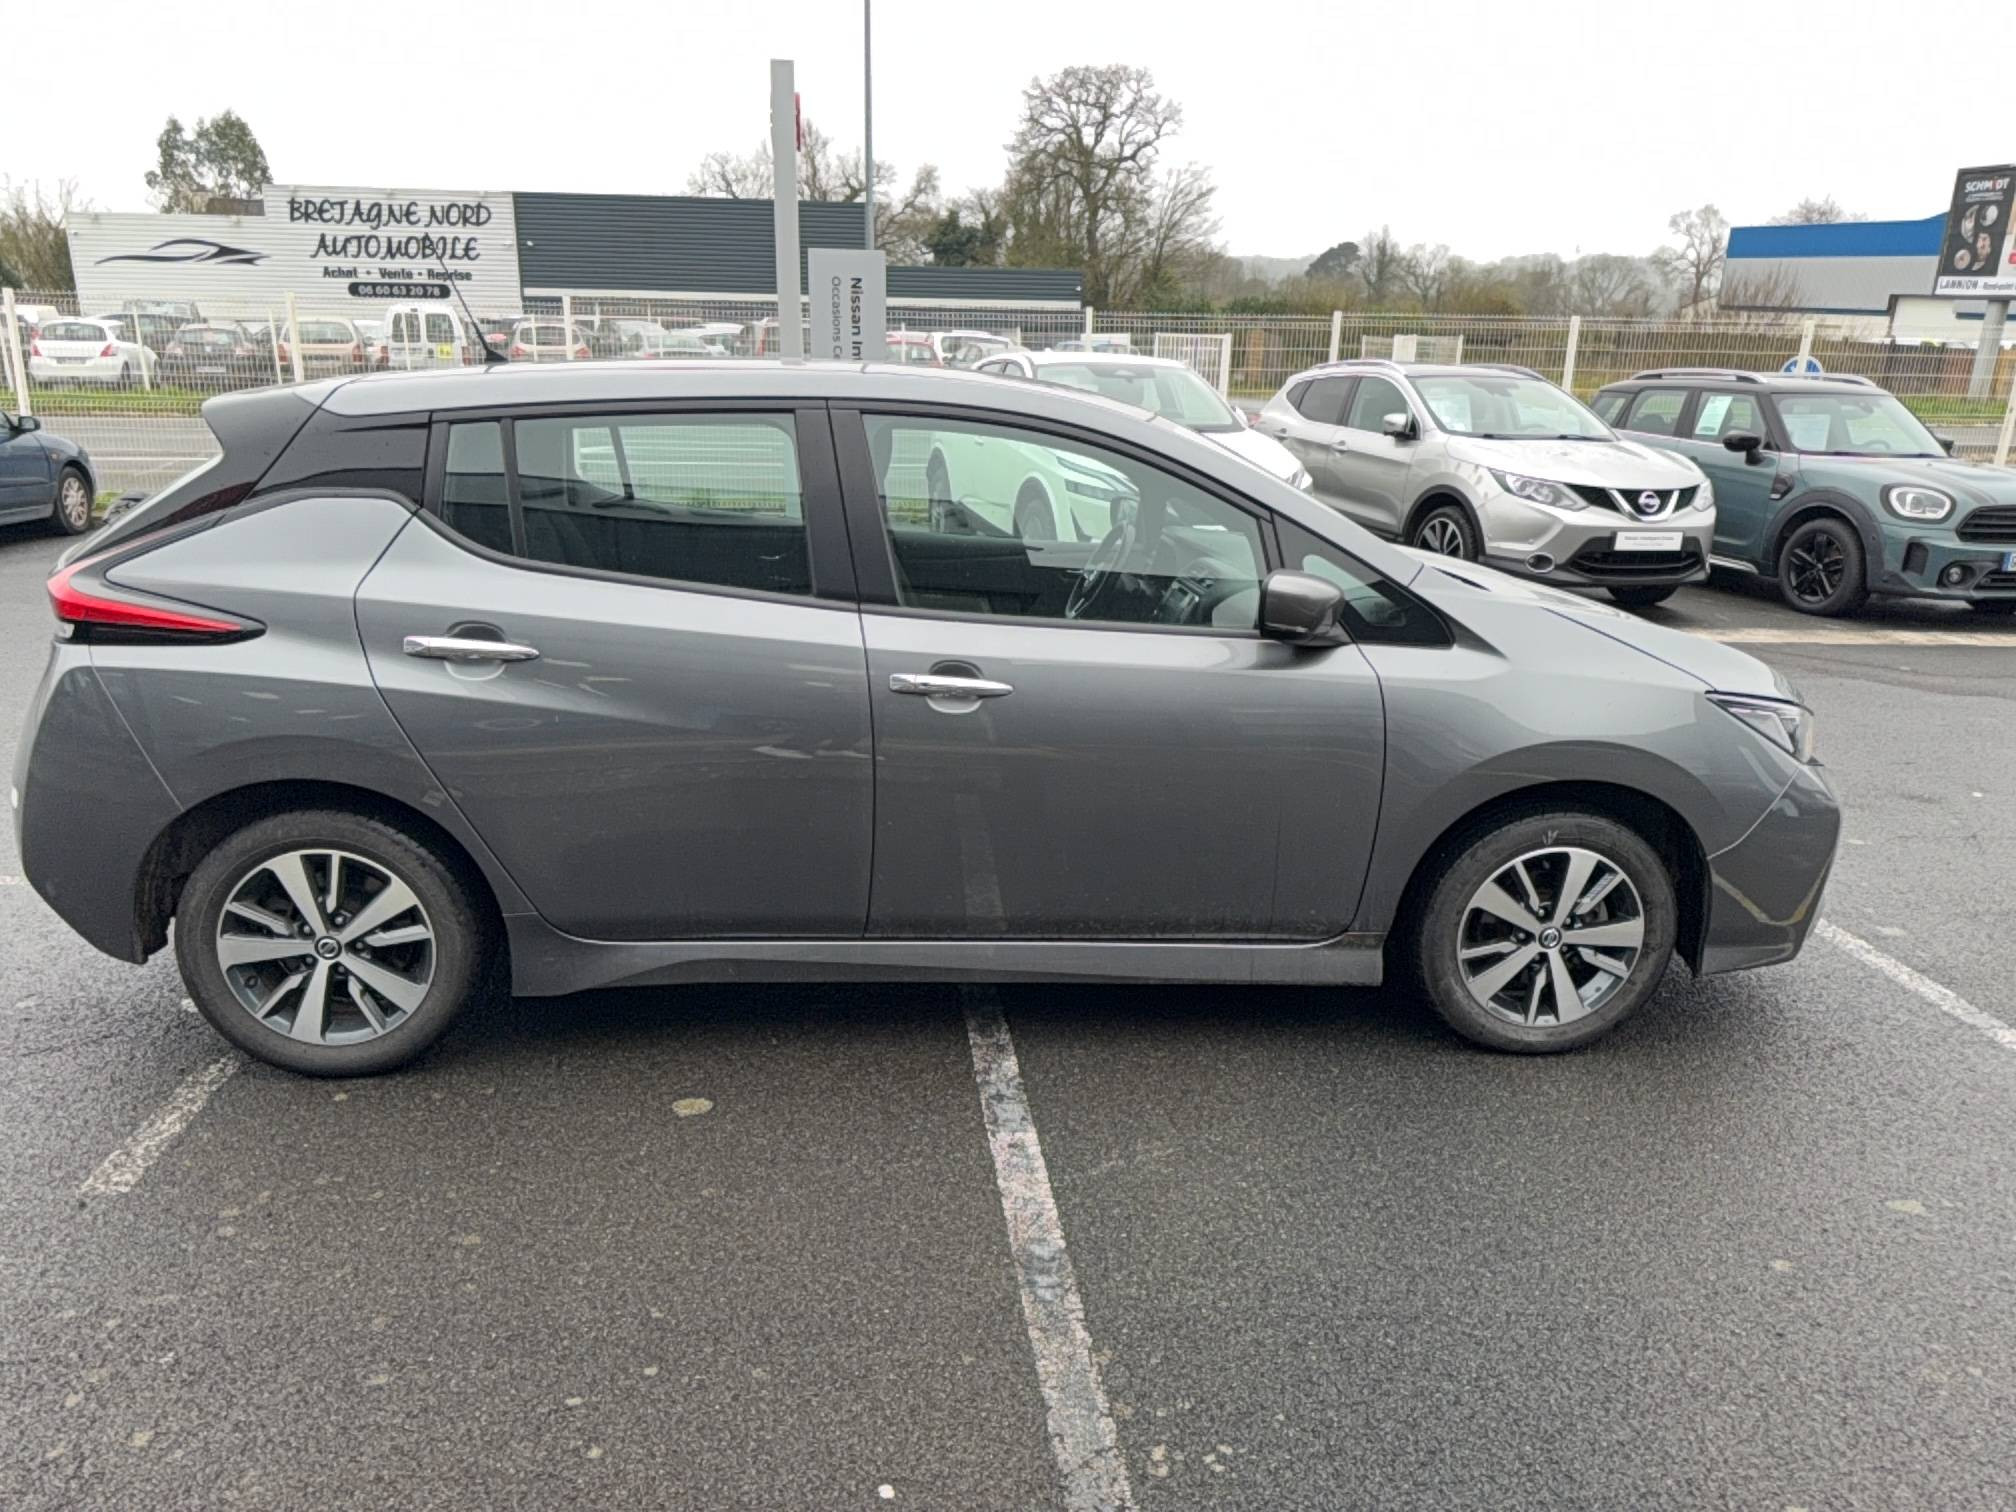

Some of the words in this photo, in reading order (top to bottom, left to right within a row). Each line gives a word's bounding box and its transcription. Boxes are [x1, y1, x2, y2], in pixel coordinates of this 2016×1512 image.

[288, 198, 421, 229] BRETAGNE
[424, 201, 491, 228] NORD
[310, 233, 480, 261] AUTOMOBILE
[322, 266, 358, 278] Achat
[378, 267, 413, 279] Vente
[426, 269, 473, 281] Reprise
[831, 276, 842, 342] Occasions
[850, 277, 863, 336] Nissan
